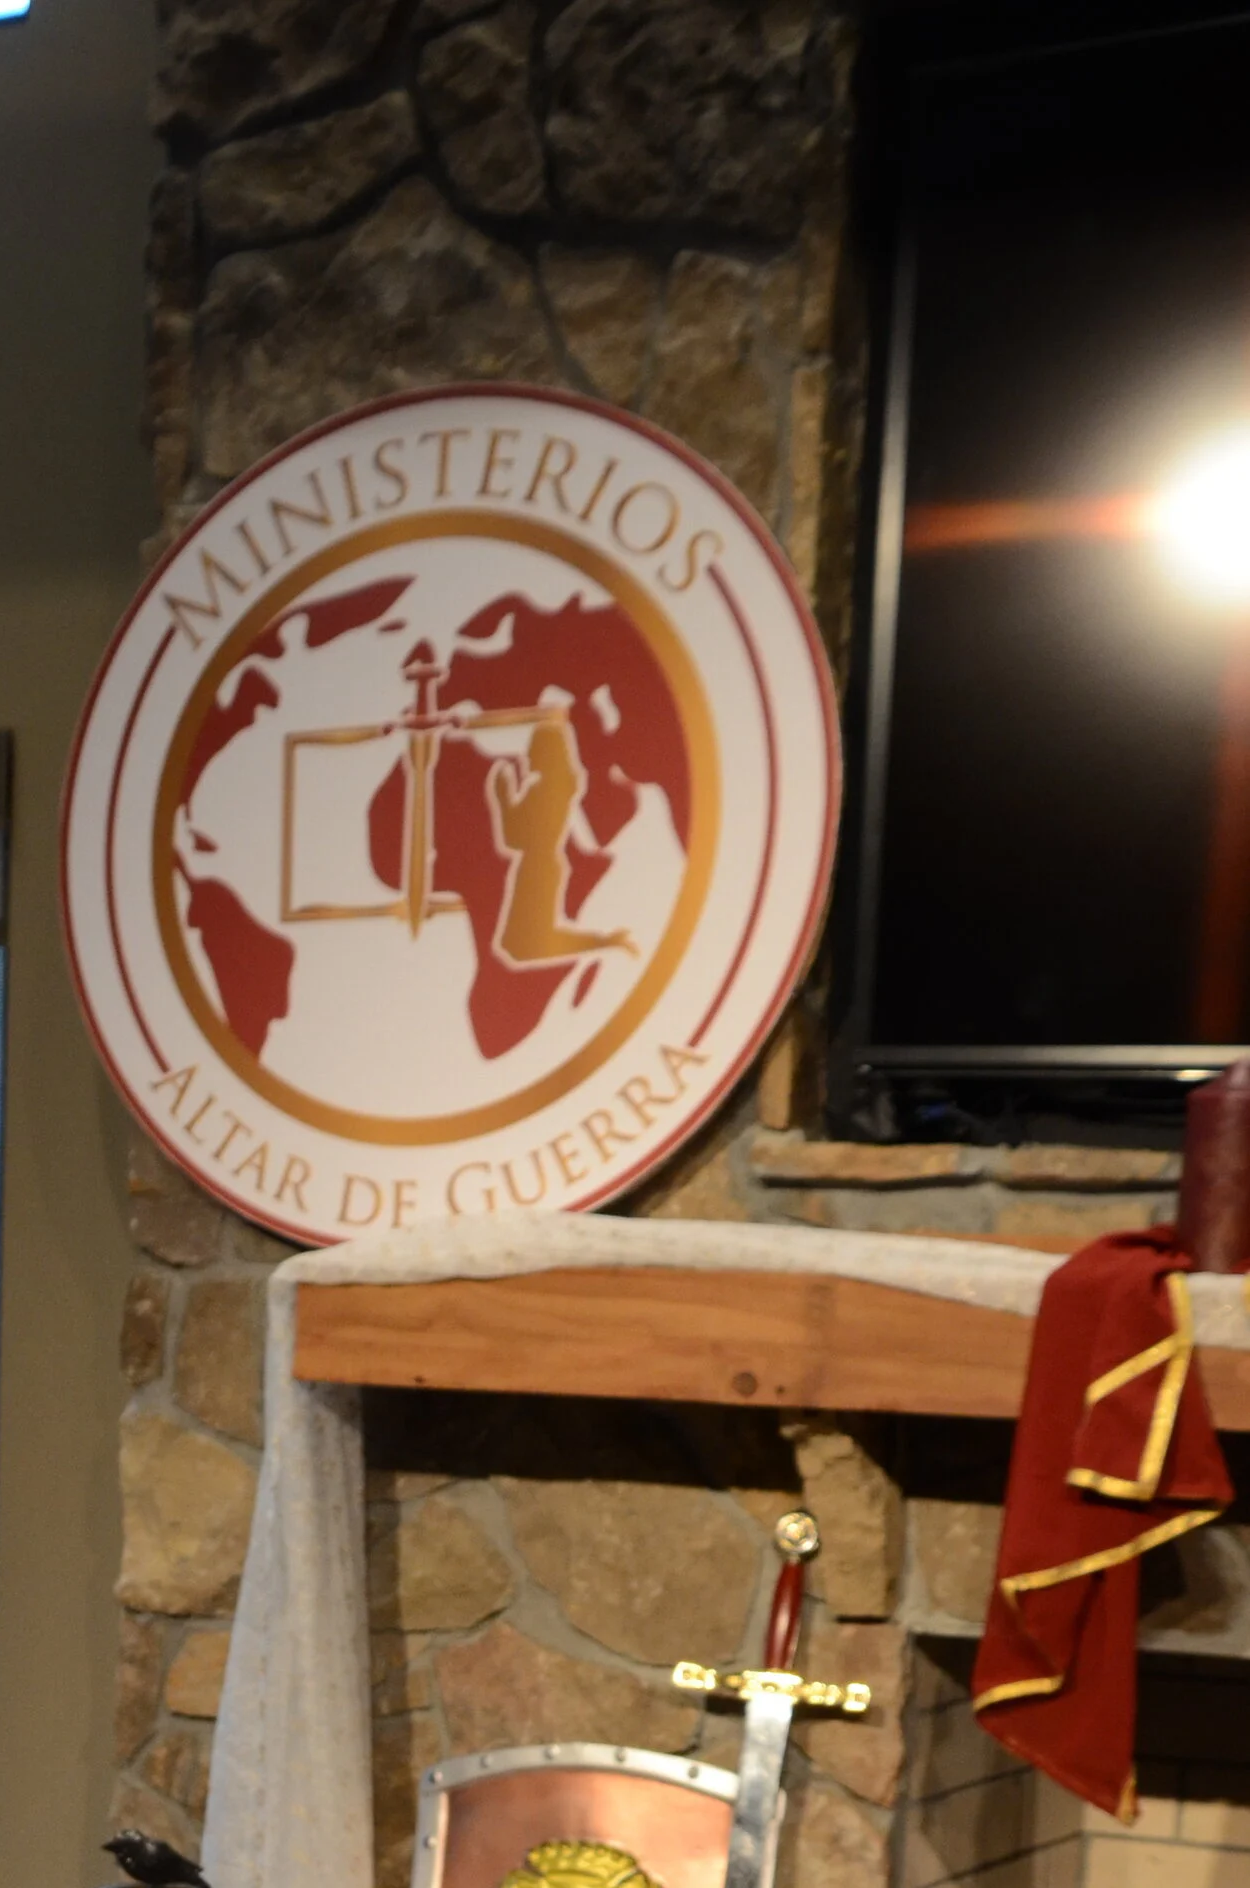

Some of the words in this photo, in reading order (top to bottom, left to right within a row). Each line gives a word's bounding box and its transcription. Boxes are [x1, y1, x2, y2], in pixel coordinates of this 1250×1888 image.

[161, 427, 726, 652] MINISTERIOS
[150, 1063, 315, 1213] ALTAR
[445, 1043, 712, 1217] GUERRA
